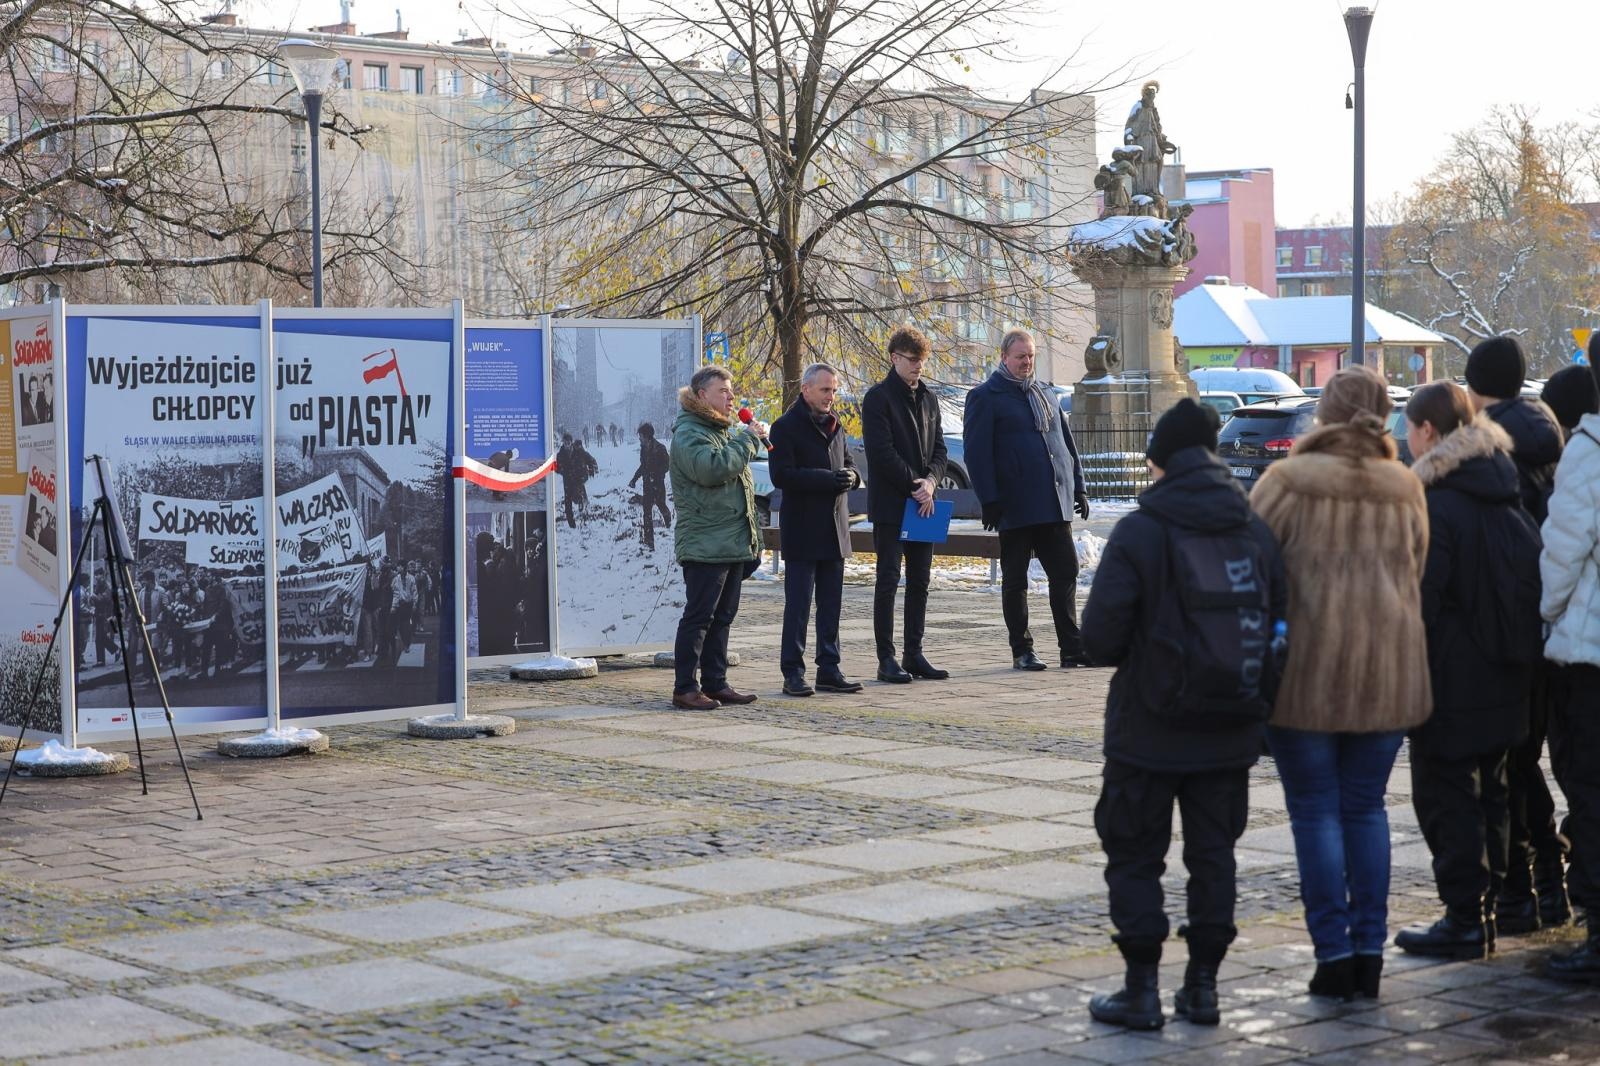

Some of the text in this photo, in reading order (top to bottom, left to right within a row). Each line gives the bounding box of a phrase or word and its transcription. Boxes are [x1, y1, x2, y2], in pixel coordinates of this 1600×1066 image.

[88, 355, 313, 390] Wyjeżdżajcie już
[152, 395, 256, 421] CHŁOPCY
[289, 397, 313, 421] od
[124, 434, 257, 448] ŚLĄSK W WALCE O WOLNĄ POLSKĘ
